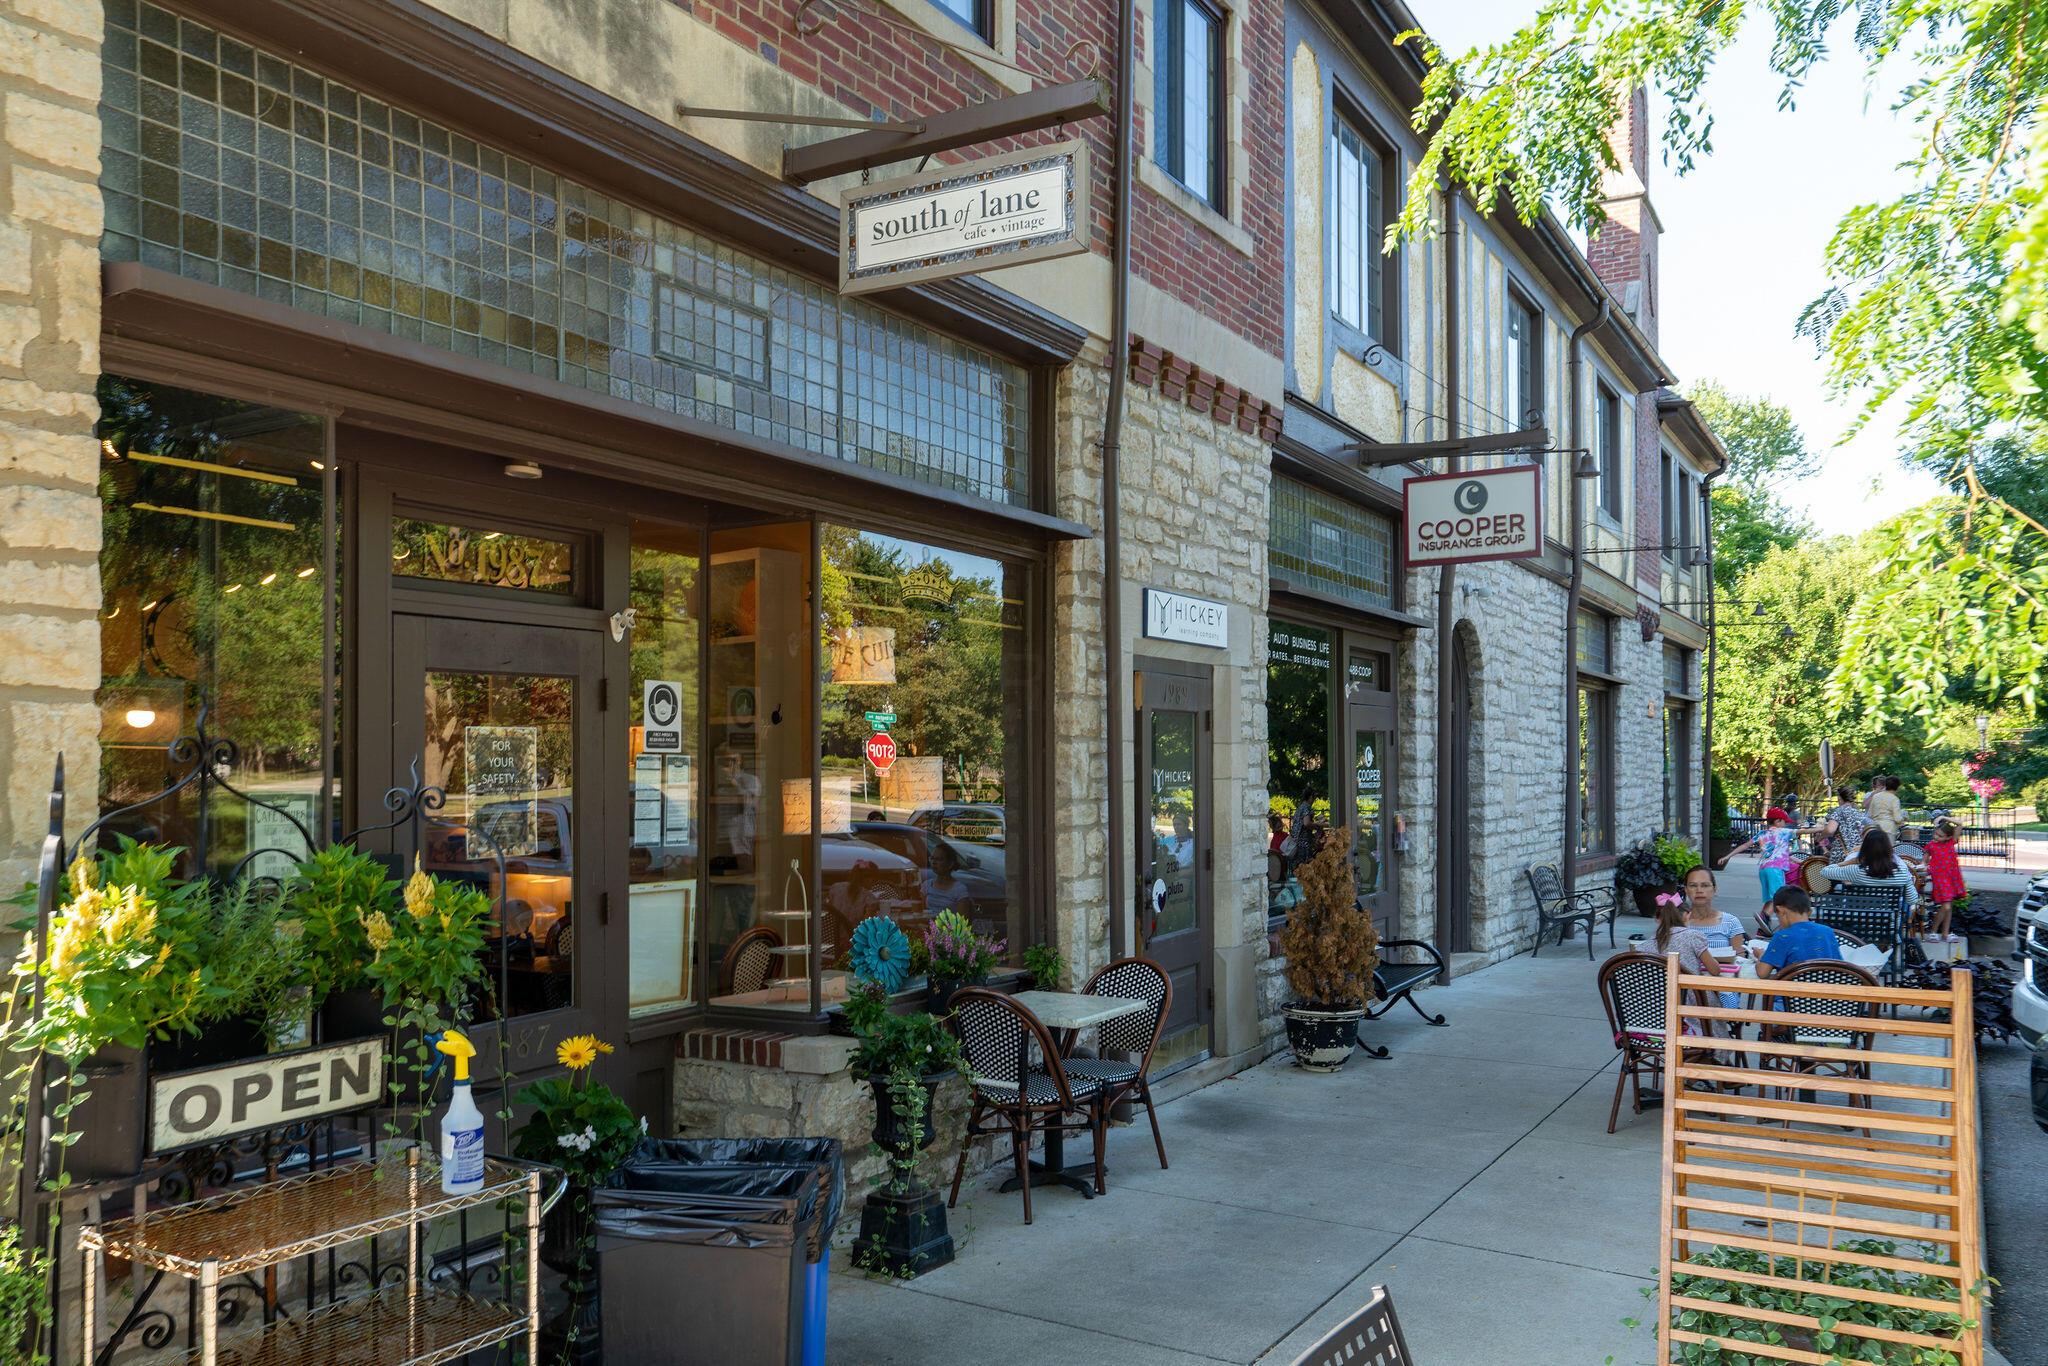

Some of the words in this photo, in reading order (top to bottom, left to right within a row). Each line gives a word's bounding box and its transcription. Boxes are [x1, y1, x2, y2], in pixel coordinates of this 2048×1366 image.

[873, 200, 948, 240] south
[954, 199, 975, 232] of
[980, 189, 1040, 218] lane
[964, 224, 987, 241] cafe
[1001, 215, 1046, 233] vintage
[1418, 513, 1526, 540] COOPER
[1418, 537, 1483, 552] INSURANCE
[1485, 534, 1525, 546] GROUP
[473, 539, 546, 589] 1987
[1175, 601, 1223, 627] HICKEY
[1273, 632, 1289, 646] AUTO
[1292, 636, 1317, 651] BUSINESS
[1319, 642, 1330, 654] LIFE
[1293, 654, 1311, 665] BETTER
[1311, 657, 1330, 668] SERVICE
[492, 741, 511, 751] FOR
[488, 757, 514, 768] YOUR
[1358, 769, 1381, 781] COOPER
[952, 825, 964, 835] THE
[964, 825, 993, 836] HIGHWAY
[1168, 882, 1184, 898] pluto
[168, 1052, 372, 1134] OPEN
